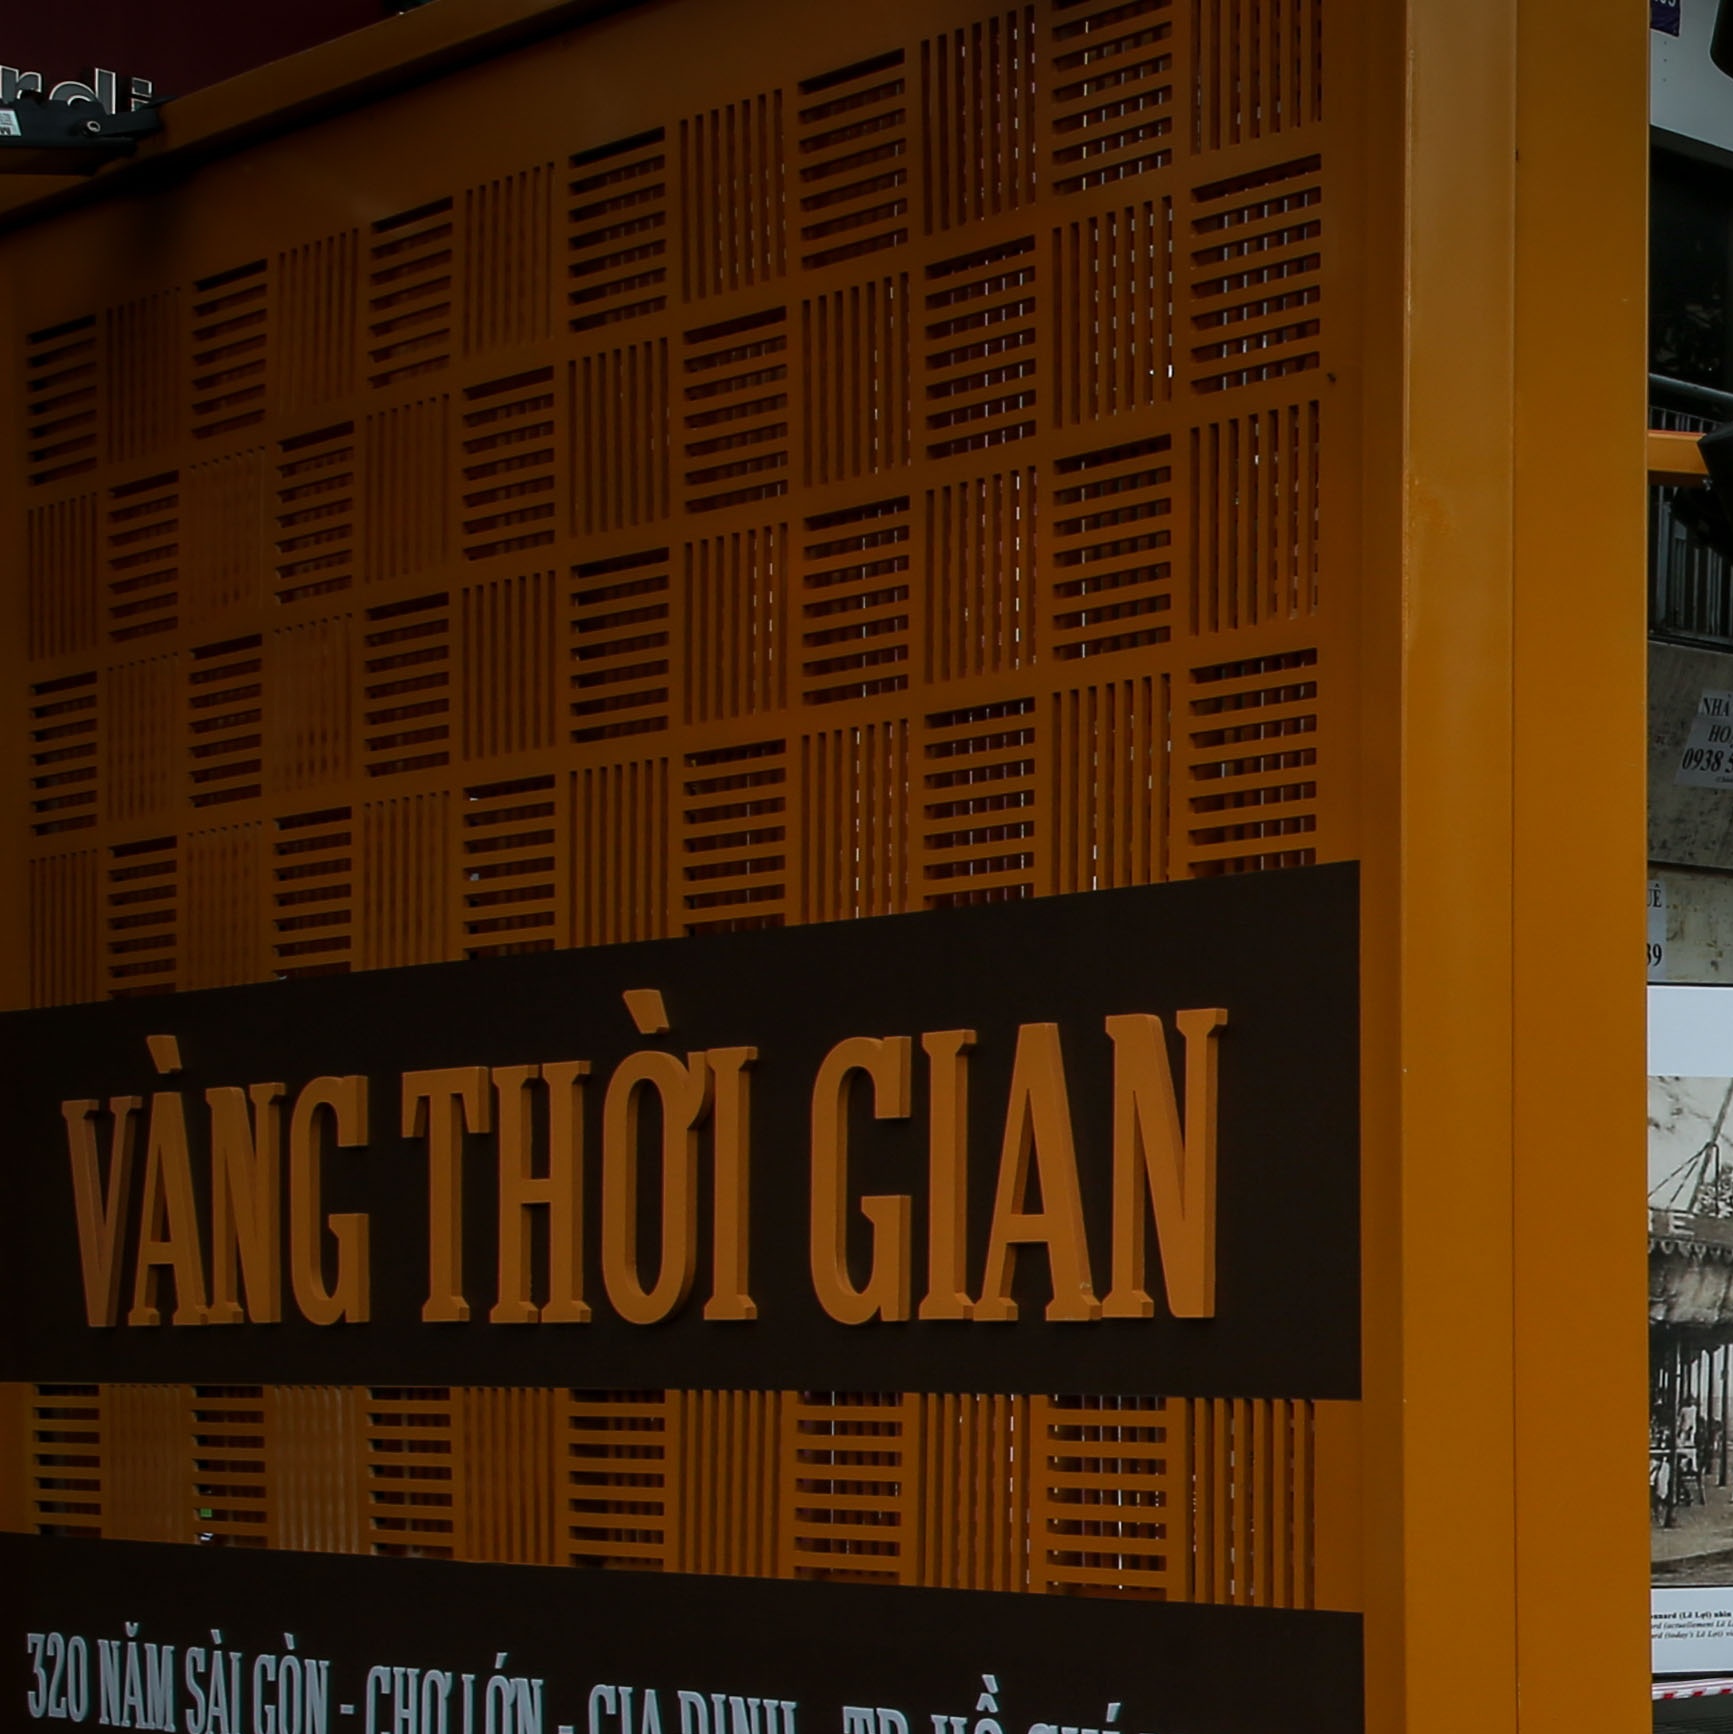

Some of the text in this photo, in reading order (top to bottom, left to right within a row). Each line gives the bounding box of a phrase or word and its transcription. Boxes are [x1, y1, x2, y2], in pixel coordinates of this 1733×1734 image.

[1682, 748, 1724, 772] 0938
[60, 988, 1228, 1328] VÀNG THỜI GIAN
[26, 1632, 88, 1722] 320
[98, 1621, 177, 1733] NĂM
